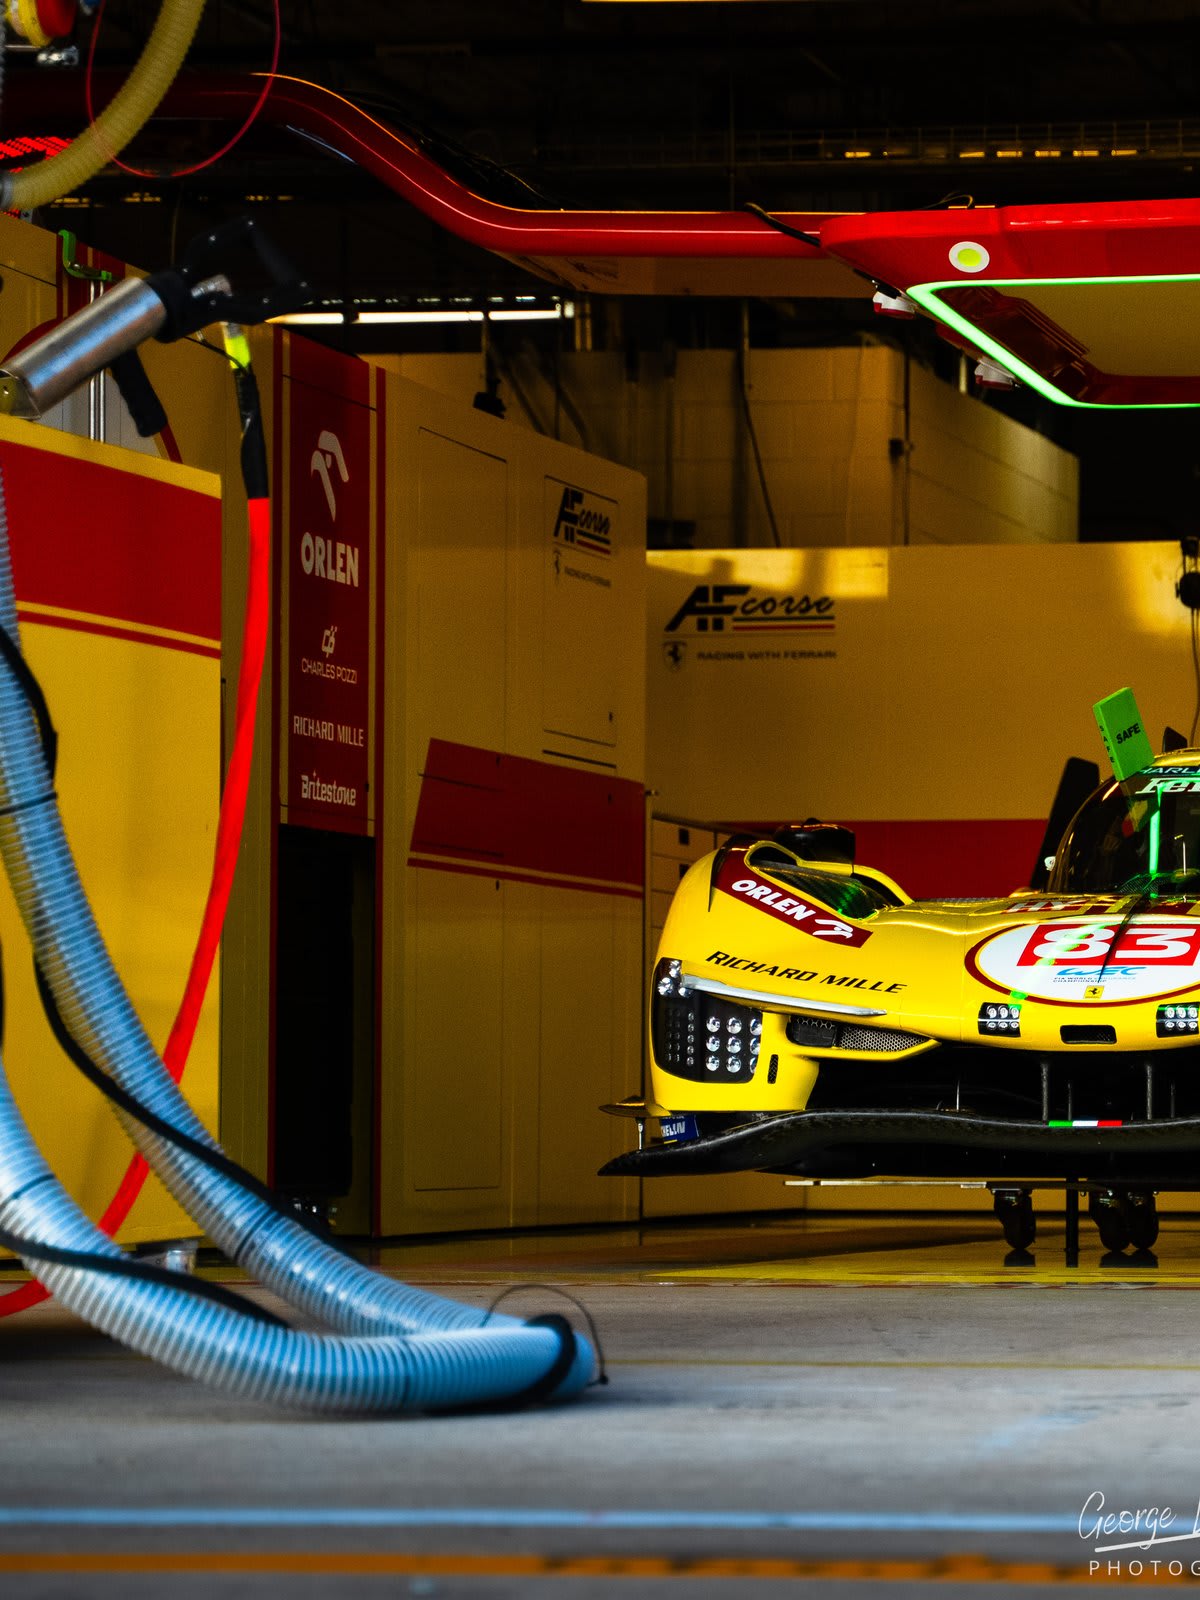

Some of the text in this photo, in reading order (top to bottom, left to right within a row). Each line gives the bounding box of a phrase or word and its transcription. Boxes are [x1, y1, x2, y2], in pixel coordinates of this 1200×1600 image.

[301, 531, 359, 588] ORLEN
[301, 657, 358, 685] CHARLES POZZI
[293, 715, 364, 747] RICHARD MILLE
[1116, 722, 1141, 744] SAFE
[731, 879, 815, 921] ORLEN
[1032, 928, 1197, 959] 83
[705, 951, 907, 994] RICHARD MILLE
